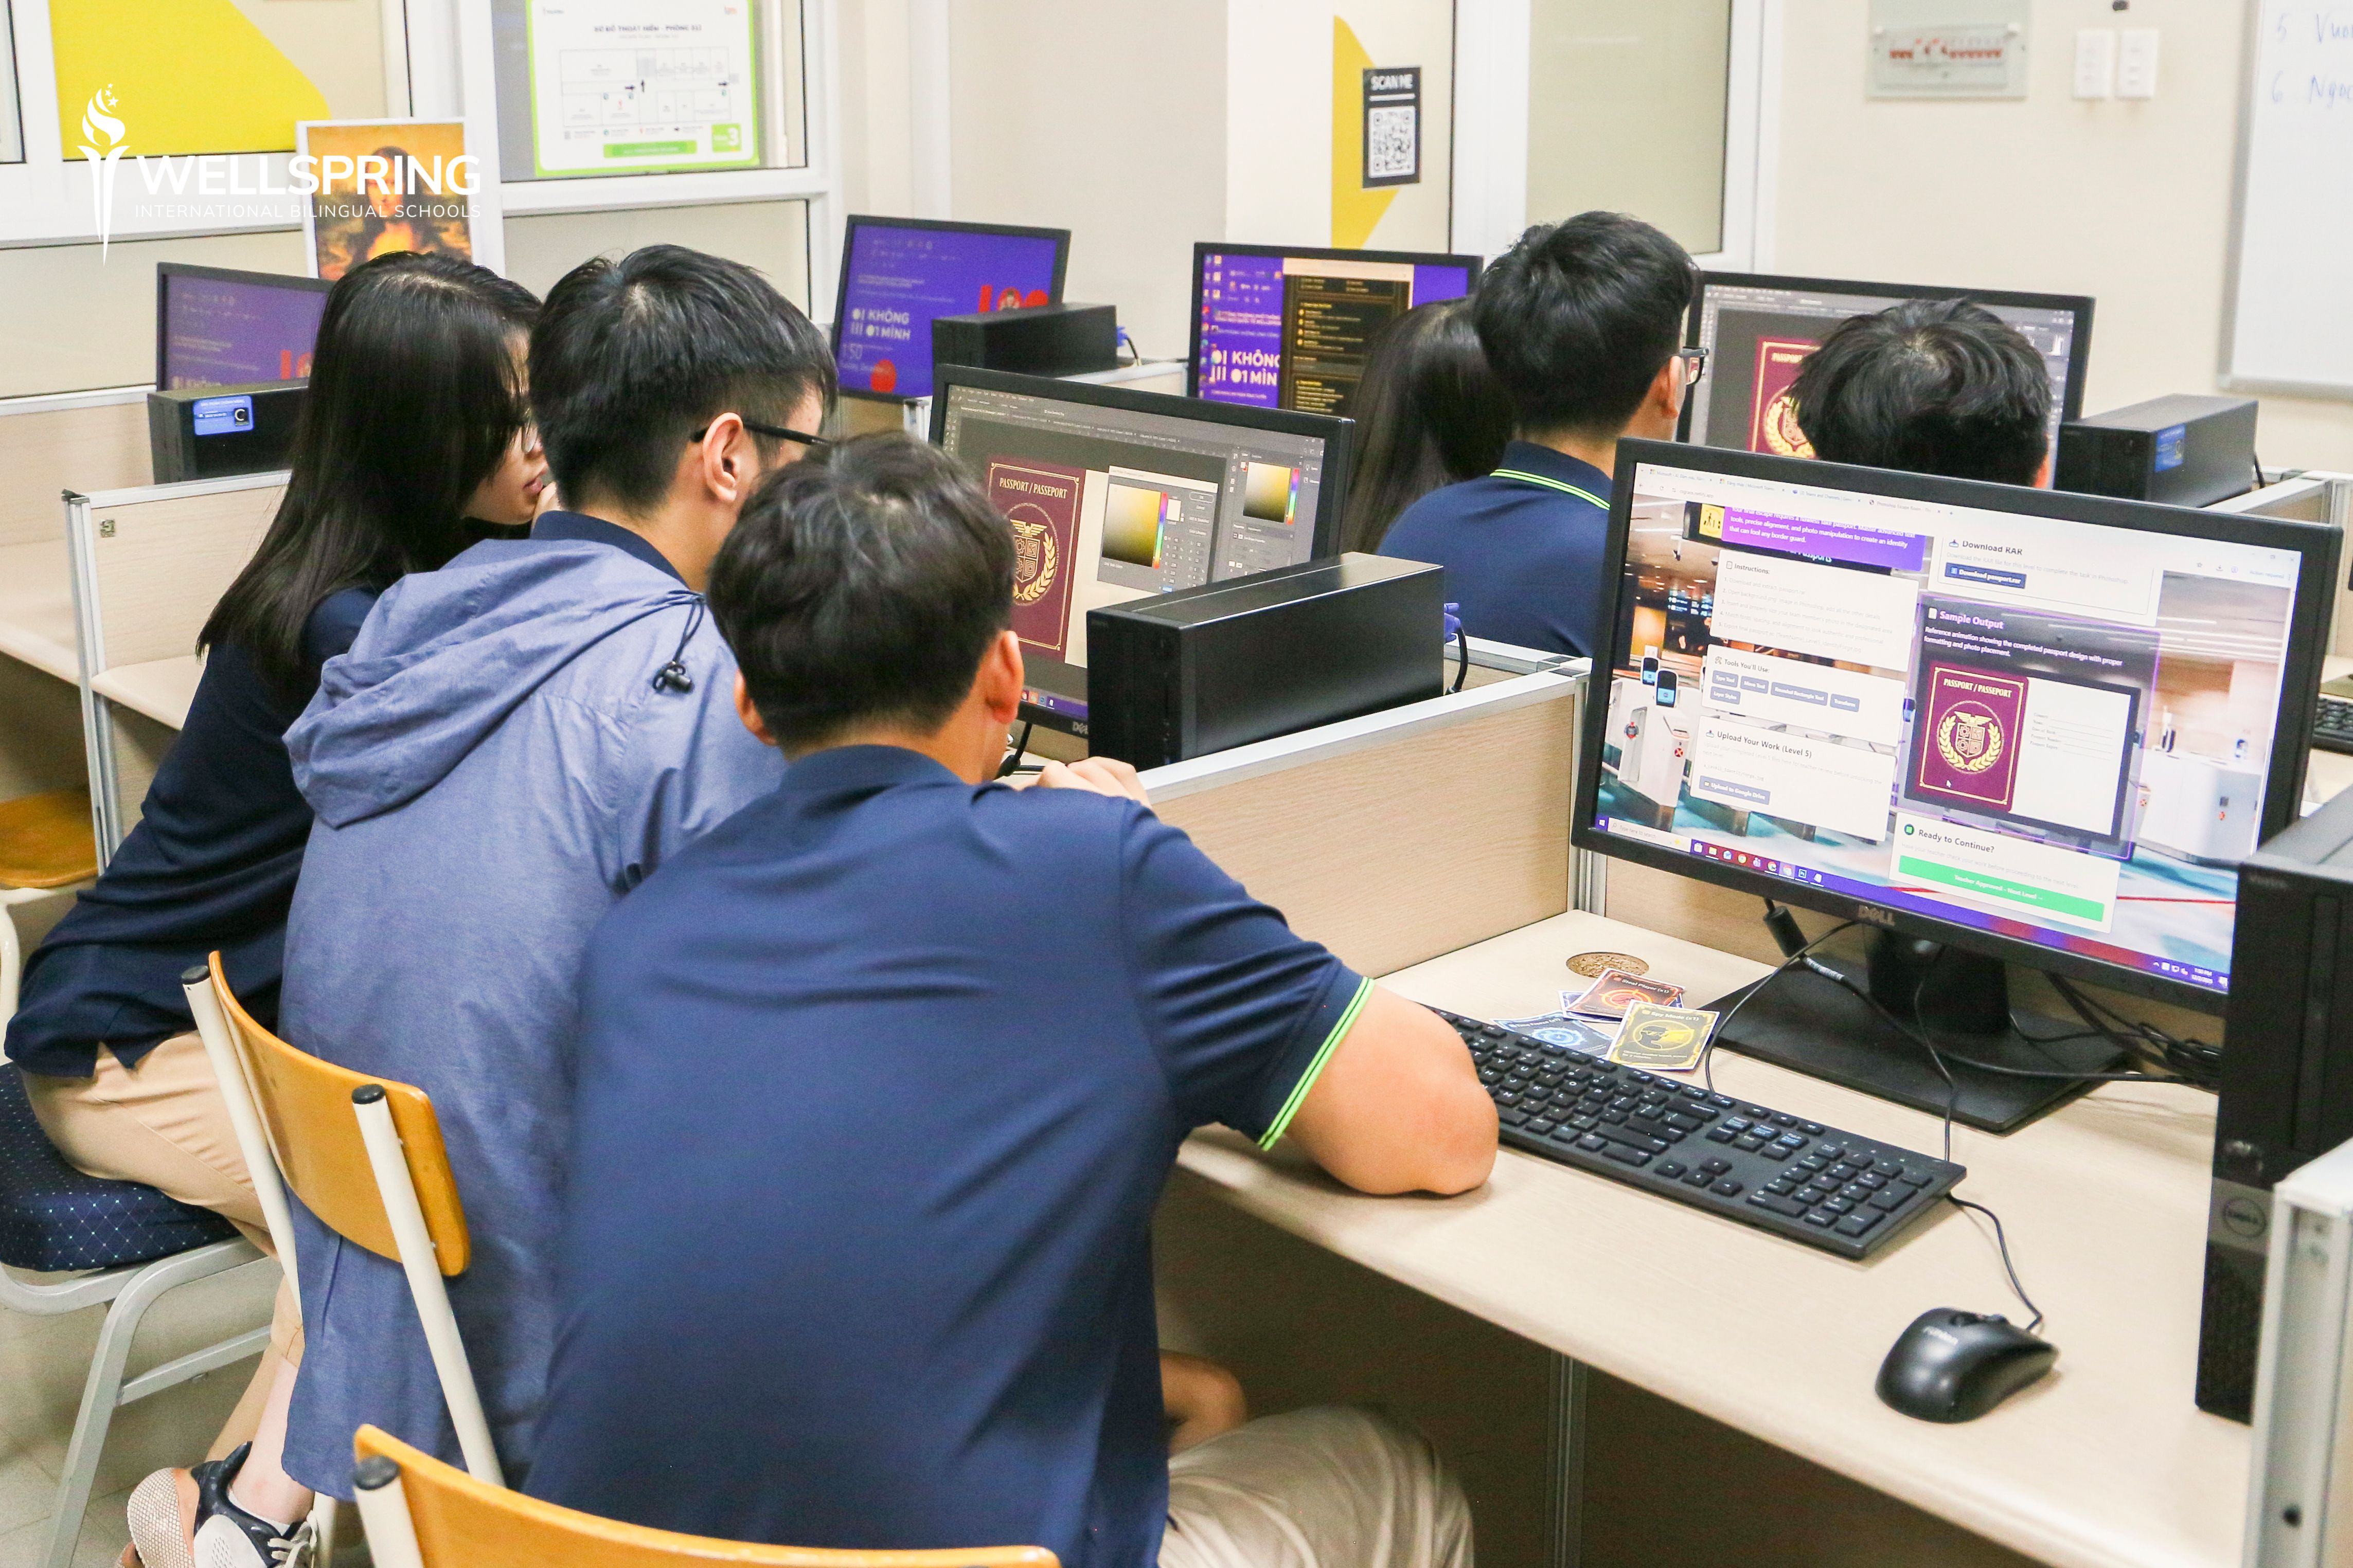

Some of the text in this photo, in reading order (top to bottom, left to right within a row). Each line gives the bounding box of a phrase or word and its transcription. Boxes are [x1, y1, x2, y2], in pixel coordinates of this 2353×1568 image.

[727, 128, 739, 146] 3
[868, 308, 910, 325] KHÔNG
[999, 477, 1029, 492] PASSPORT
[1033, 484, 1068, 499] PASSEPORT
[1728, 525, 1807, 544] that can fool any border guard.
[1730, 515, 1744, 524] tools,
[1744, 517, 1763, 527] precise
[1791, 524, 1802, 533] and
[1802, 526, 1819, 535] photo
[1818, 528, 1853, 540] manipulation
[1853, 533, 1861, 542] to
[1860, 534, 1878, 544] create
[1878, 537, 1886, 545] an
[1886, 538, 1908, 549] identity
[1962, 540, 2023, 556] Download RAR
[1734, 562, 1770, 575] Instructions:
[1958, 568, 1987, 579] Download
[1938, 610, 2005, 632] Sample Output
[1923, 635, 2011, 658] formatting and photo placement.
[1924, 626, 2123, 668] Reference animation showing the completed passport design with proper
[1724, 659, 1770, 673] Tools You'll Use:
[1942, 677, 2012, 699] PASSPORT / PASSEPORT
[1073, 721, 1089, 734] DEL
[1716, 730, 1812, 759] Upload Your Work (Level 5)
[1917, 828, 1995, 854] Ready to Continue?
[1953, 874, 1975, 885] Teacher
[1974, 879, 2003, 893] Approved
[2006, 887, 2022, 896] Next
[2021, 890, 2037, 900] Level
[1858, 905, 1895, 926] DELL
[1621, 978, 1638, 987] Steal
[1638, 982, 1657, 991] Player
